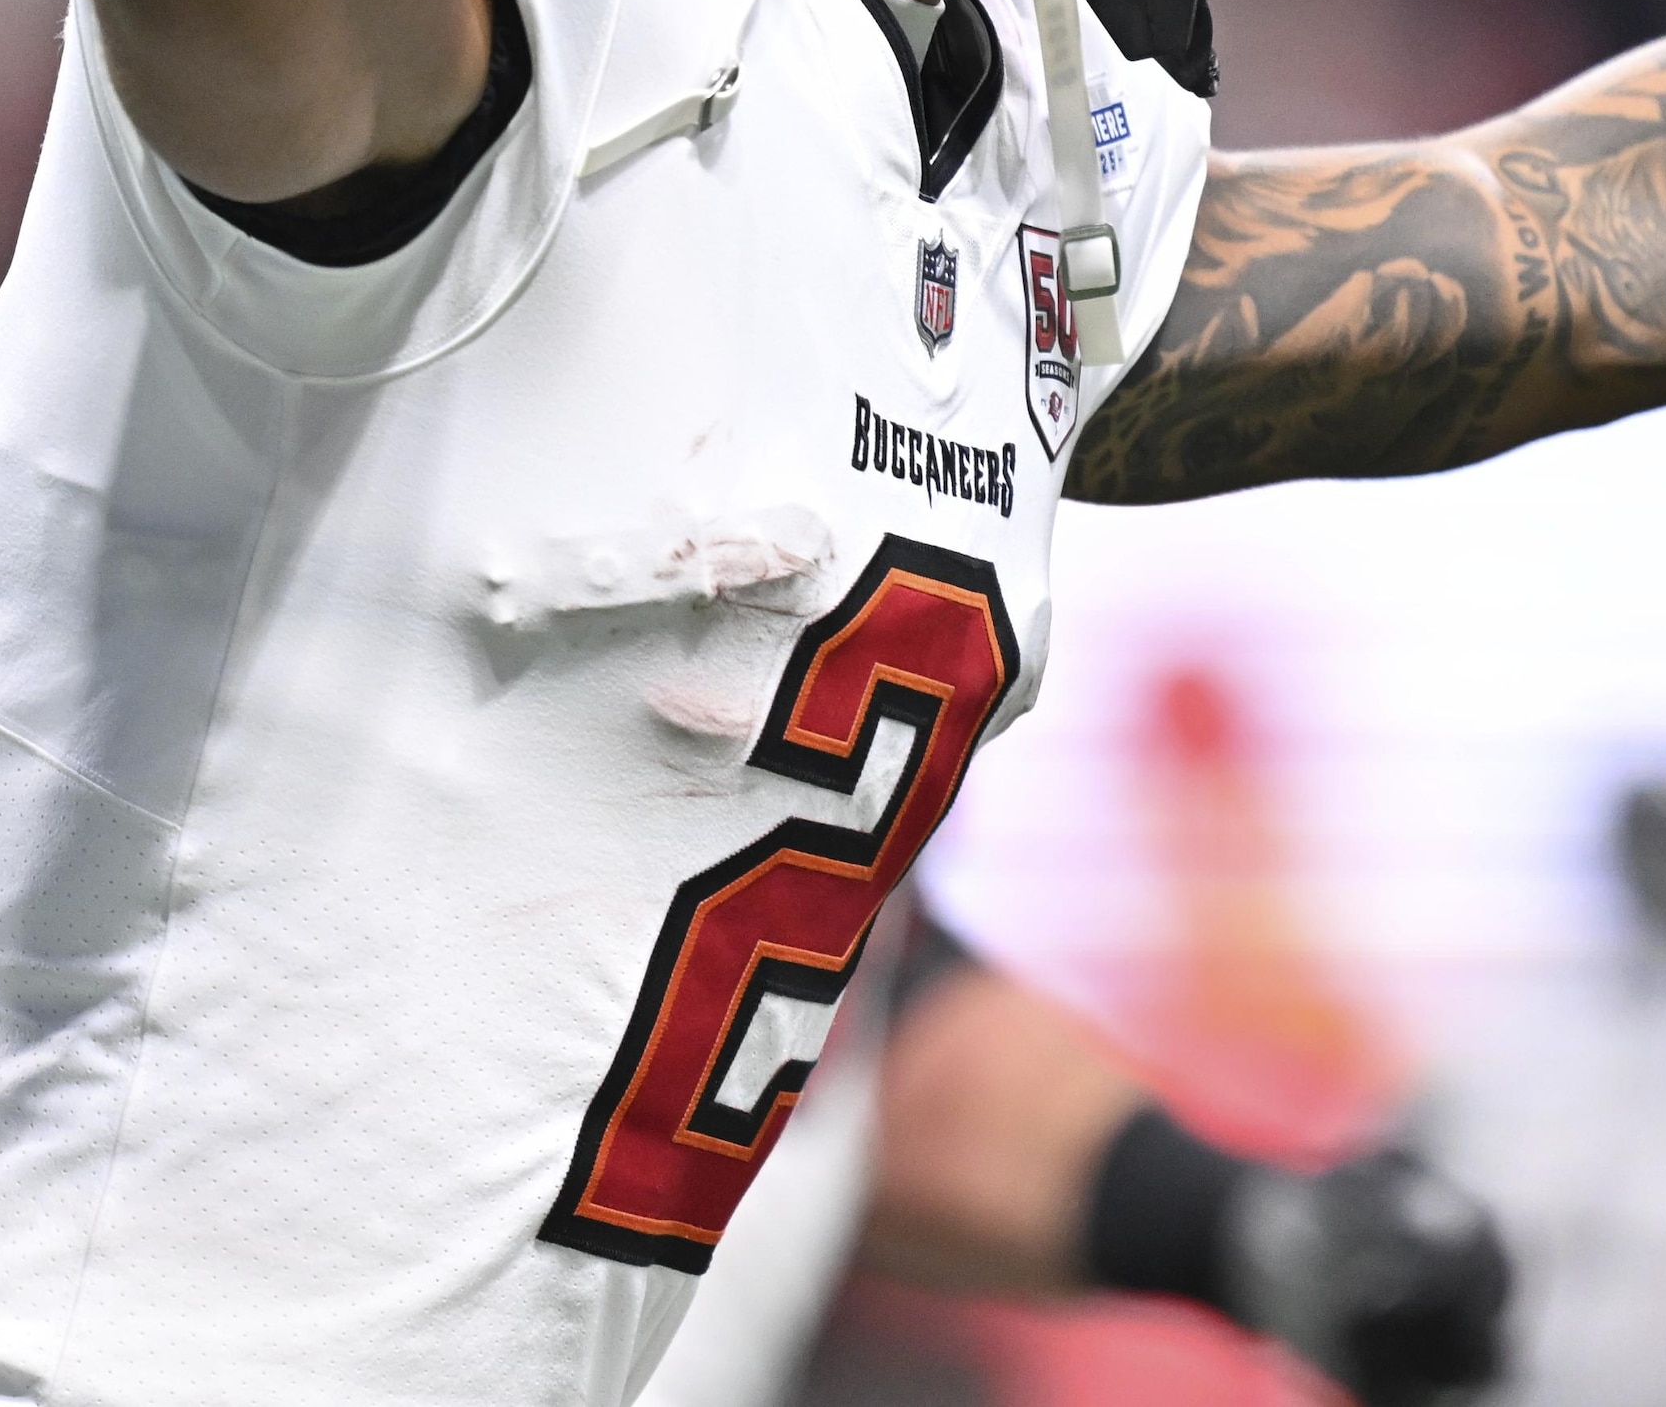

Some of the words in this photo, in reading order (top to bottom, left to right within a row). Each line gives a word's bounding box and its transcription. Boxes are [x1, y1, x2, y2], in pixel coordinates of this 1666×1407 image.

[923, 282, 953, 332] NFL
[1030, 249, 1079, 363] 50
[1040, 363, 1072, 384] SEASONS
[851, 391, 1016, 519] BUCCANEERS
[536, 532, 1022, 1276] 2
